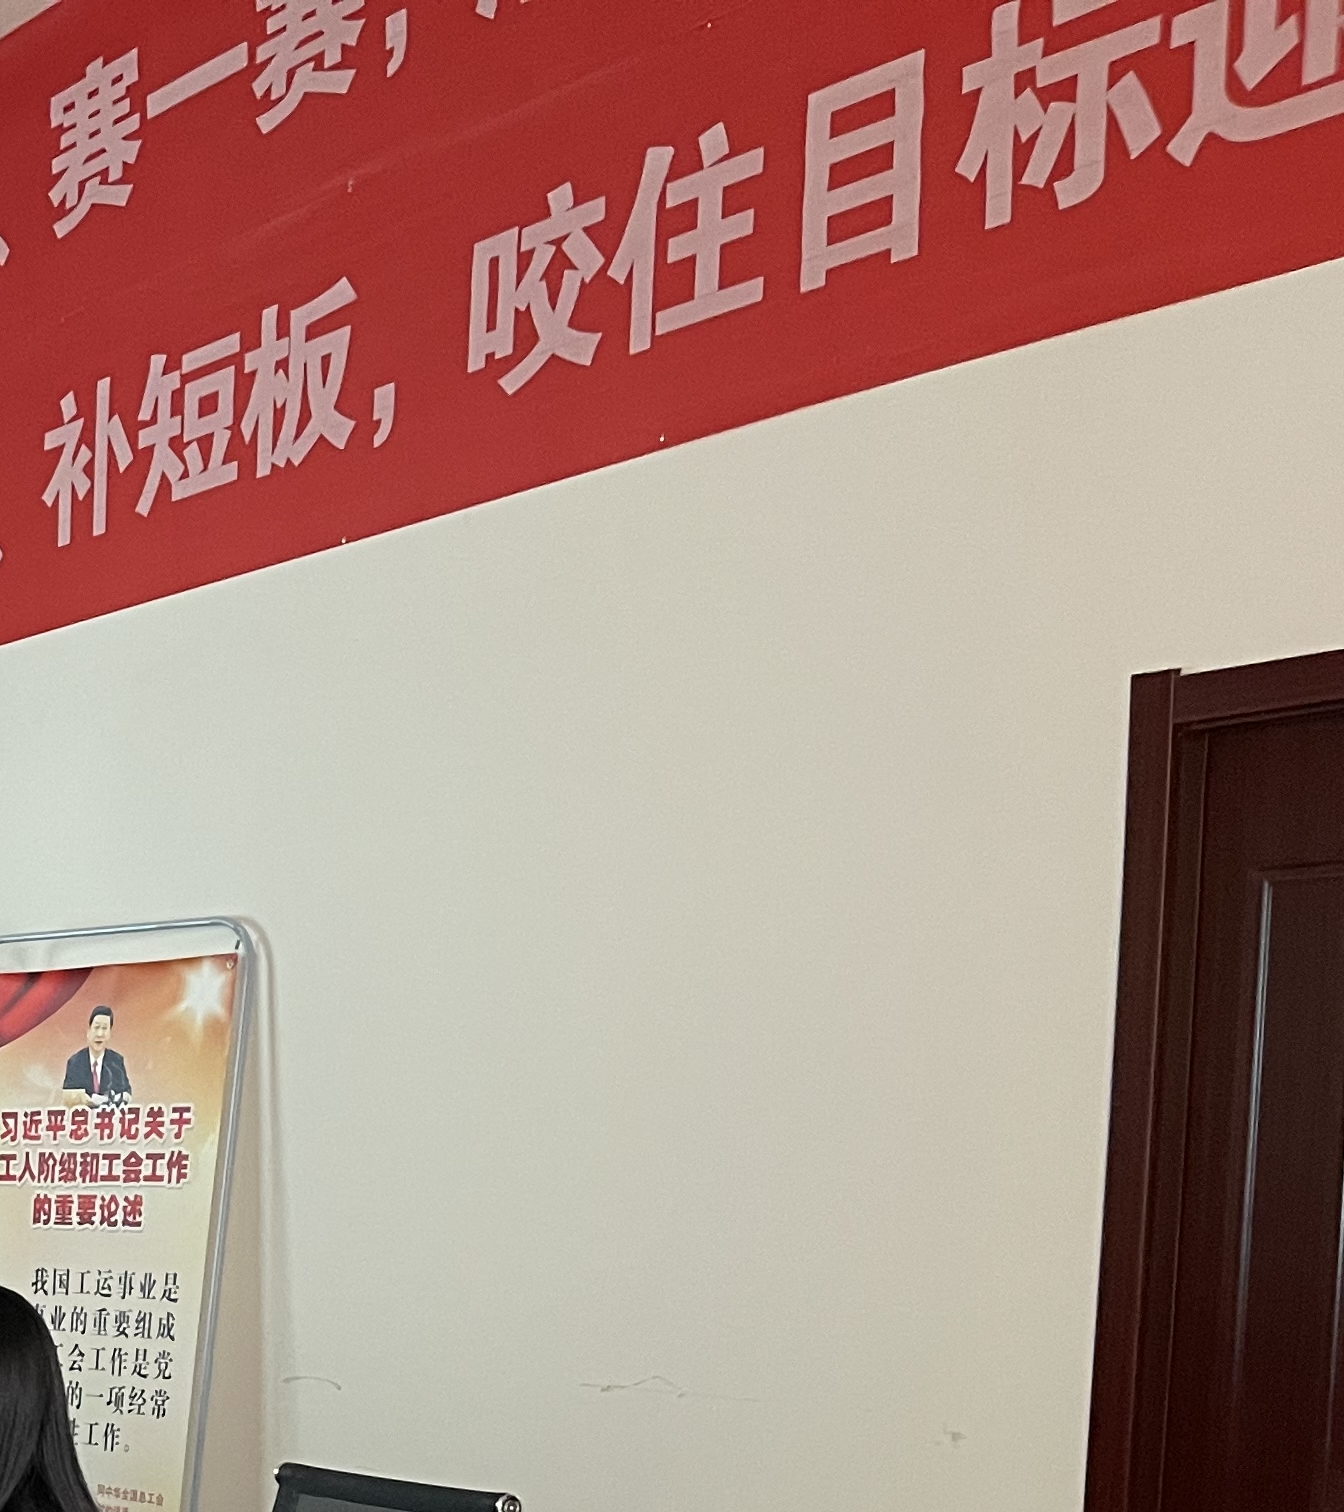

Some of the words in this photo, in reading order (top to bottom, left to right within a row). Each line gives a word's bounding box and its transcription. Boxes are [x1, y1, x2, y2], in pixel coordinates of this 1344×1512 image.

[0, 1105, 192, 1142] 习近平总书记关于
[32, 1193, 144, 1228] 的重要论述
[31, 1266, 180, 1304] 我国工运事业是
[66, 1379, 171, 1420] 的一项经常
